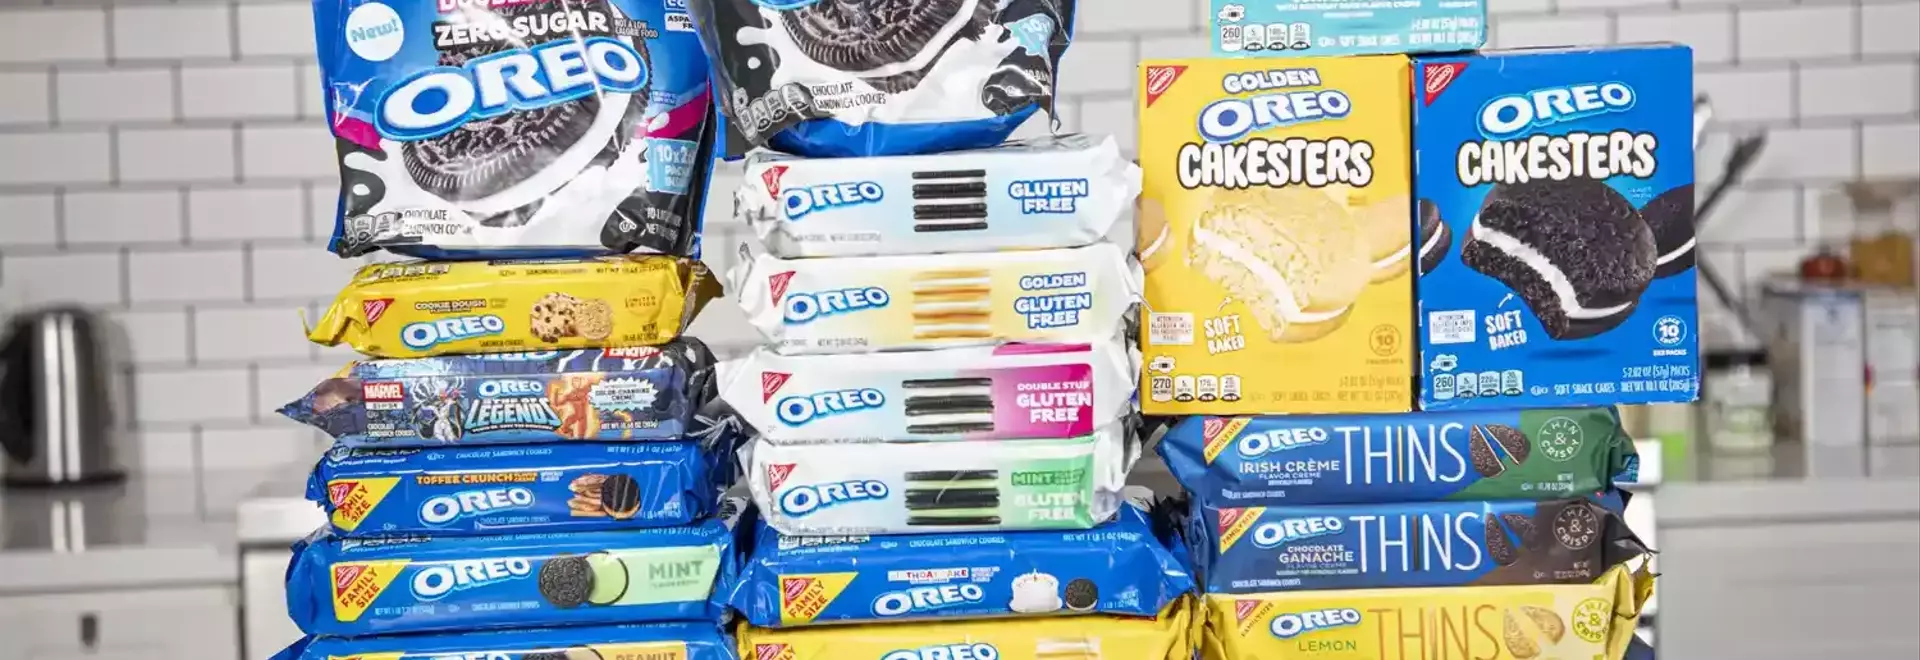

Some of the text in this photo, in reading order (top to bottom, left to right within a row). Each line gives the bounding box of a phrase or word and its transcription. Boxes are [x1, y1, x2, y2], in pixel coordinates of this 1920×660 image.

[351, 19, 399, 42] New!
[435, 10, 609, 46] ZERO SUGAR
[641, 30, 658, 38] FOOD
[1223, 28, 1240, 38] 260
[380, 39, 643, 132] OREO
[812, 81, 854, 96] CHOCOLATE
[1224, 69, 1320, 93] GOLDEN
[814, 93, 886, 110] SANDWICH COOKIES
[1480, 82, 1633, 135] OREO
[1200, 91, 1351, 140] OREO
[1178, 136, 1374, 189] CAKESTERS
[1458, 131, 1657, 186] CAKESTERS
[1009, 179, 1088, 198] GLUTEN
[785, 182, 883, 218] OREO
[1023, 198, 1075, 213] FREE
[1020, 273, 1085, 289] GOLDEN
[415, 299, 486, 309] COOKIE DOUGH
[785, 287, 889, 323] OREO
[1015, 293, 1091, 313] GLUTEN
[1028, 310, 1079, 328] FREE
[1204, 315, 1240, 338] SOFT
[1485, 310, 1522, 334] SOFT
[402, 315, 504, 348] OREO
[1376, 335, 1394, 346] 10
[1489, 329, 1527, 351] BAKED
[1658, 326, 1680, 336] 10
[1208, 335, 1245, 355] BAKED
[1670, 365, 1690, 377] PACKS
[364, 383, 402, 398] MARVEL
[479, 380, 544, 396] OREO
[1017, 380, 1091, 391] DOUBLE STUF
[1153, 378, 1171, 389] 270
[1435, 377, 1453, 388] 260
[1554, 382, 1615, 395] SOFT SNACK CAKES
[779, 388, 884, 425] OREO
[1016, 392, 1092, 408] GLUTEN
[465, 398, 562, 430] LEGENDS
[1030, 407, 1079, 423] FREE
[1227, 420, 1242, 436] SIZE
[1543, 421, 1578, 435] THIN
[1238, 426, 1328, 456] OREO
[1554, 431, 1567, 445] &
[456, 451, 491, 459] CHOCOLATE
[1334, 422, 1466, 485] THINS
[1541, 439, 1579, 458] CRISPY
[1239, 458, 1340, 474] IRISH CRÈME
[416, 475, 461, 484] TOFFEE
[462, 473, 513, 483] CRUNCH
[1011, 471, 1053, 485] MINT
[420, 487, 531, 524] OREO
[781, 480, 888, 516] OREO
[350, 499, 373, 523] SIZE
[1028, 506, 1076, 521] FREE
[1253, 516, 1343, 546] OREO
[1569, 518, 1582, 532] &
[910, 536, 1005, 547] CHOCOLATE SANDWICH COOKIES
[1222, 527, 1243, 545] FAMILY
[1349, 512, 1481, 572] THINS
[1557, 527, 1593, 545] CRISPY
[1279, 551, 1354, 564] GANACHE
[413, 556, 531, 597] OREO
[651, 560, 703, 580] MINT
[341, 567, 378, 608] FAMILY
[356, 583, 380, 609] SIZE
[788, 580, 825, 619] FAMILY
[803, 595, 829, 619] SIZE
[873, 583, 984, 616] OREO
[1270, 609, 1361, 638] OREO
[1590, 613, 1601, 626] &
[1367, 604, 1500, 660] THINS
[1298, 640, 1357, 652] LEMON
